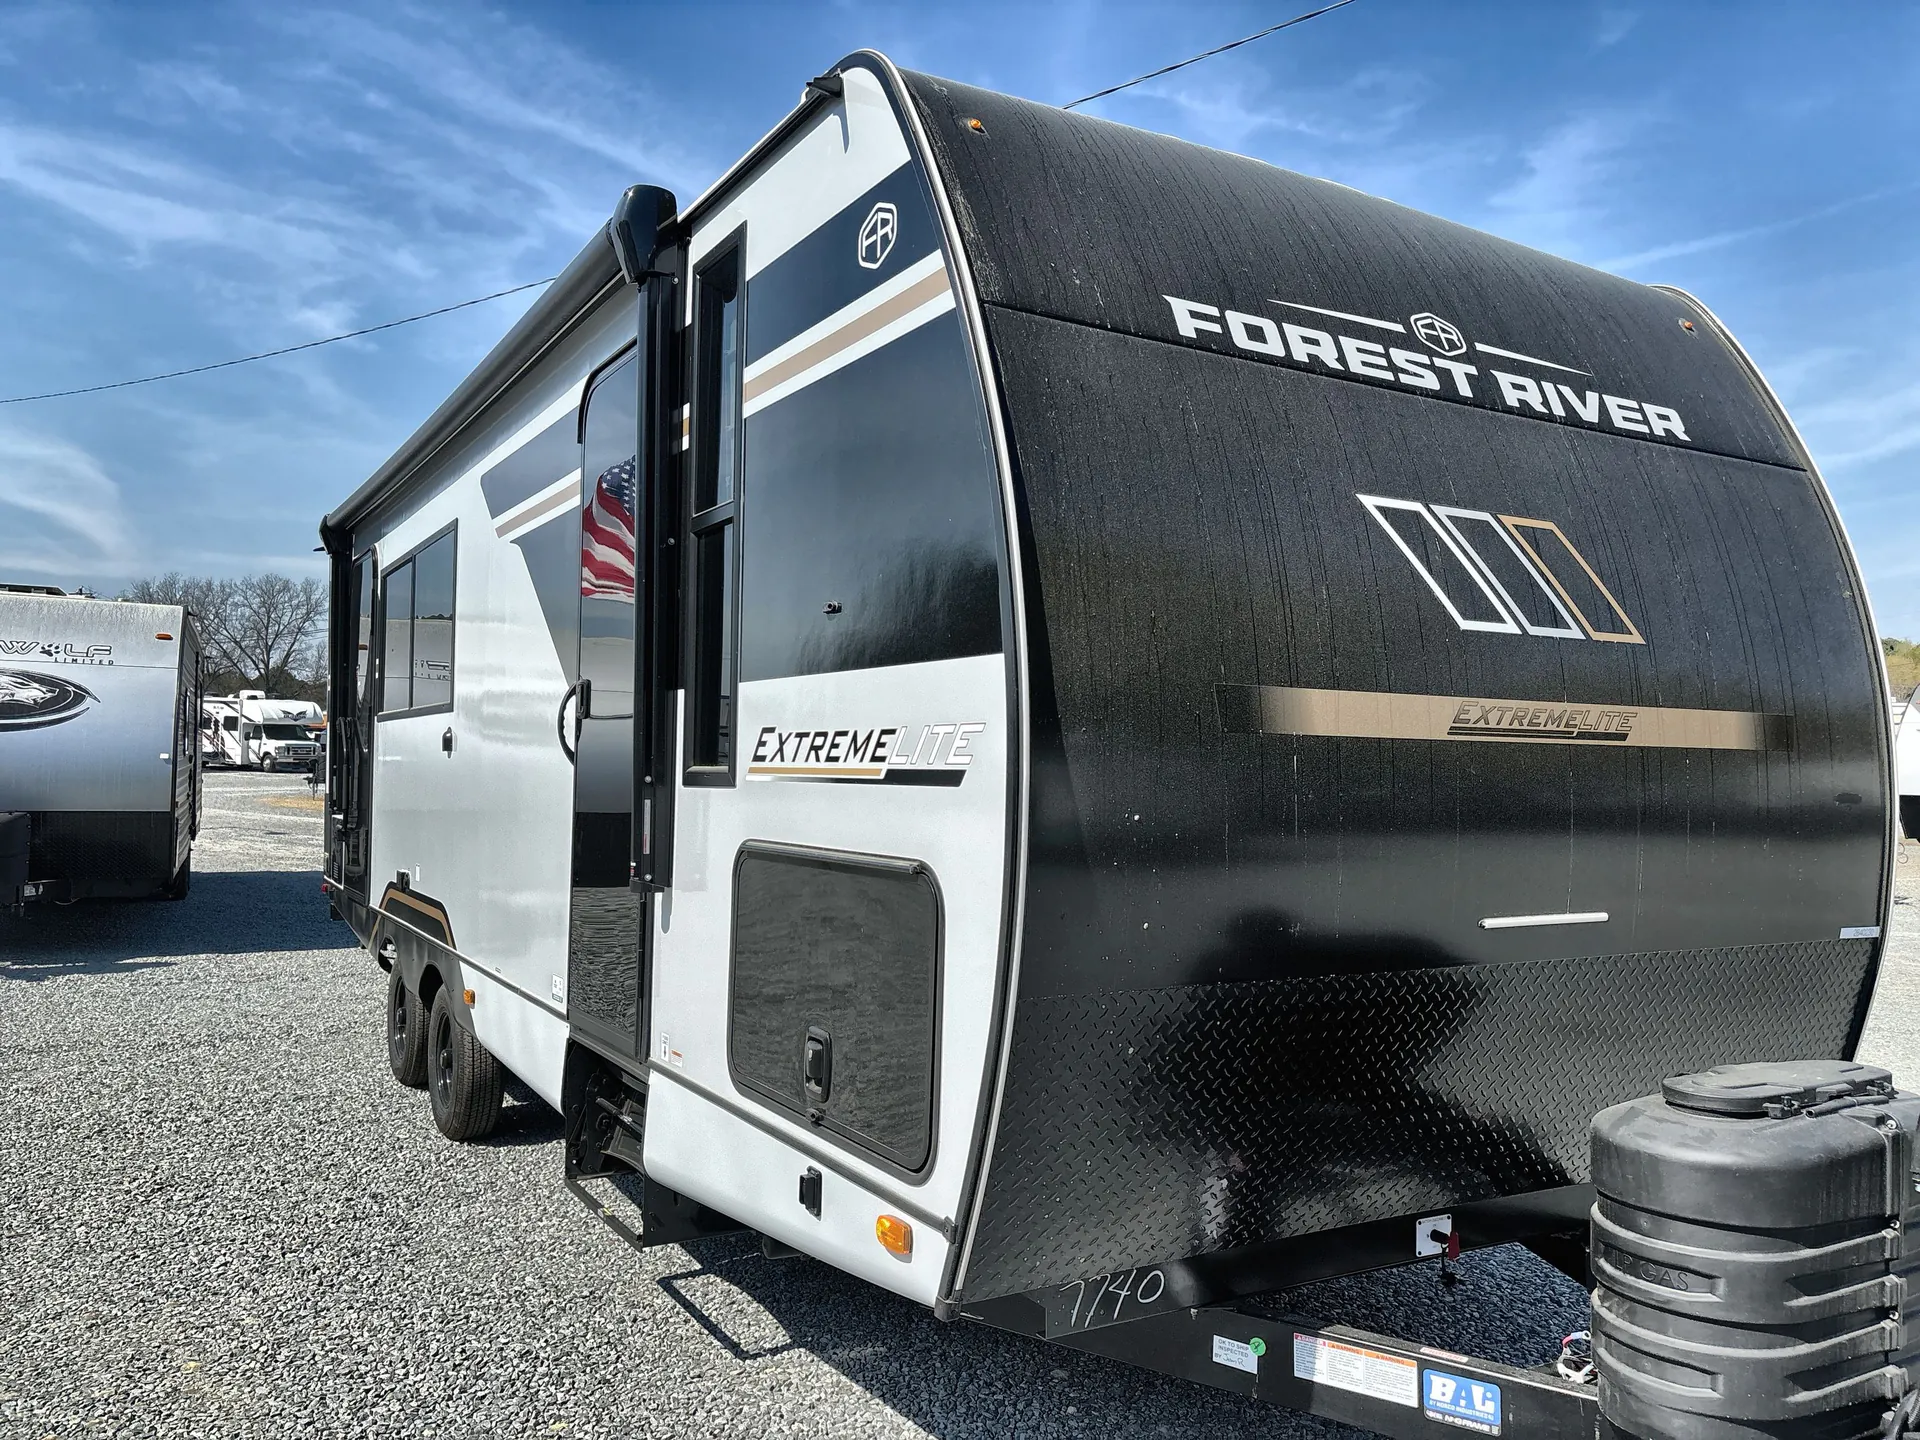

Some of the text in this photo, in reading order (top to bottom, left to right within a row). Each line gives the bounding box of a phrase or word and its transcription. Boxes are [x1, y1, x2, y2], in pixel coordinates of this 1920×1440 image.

[1163, 295, 1692, 442] FOREST RIVER
[54, 657, 114, 666] LIMITED
[1614, 1250, 1689, 1291] LP GAS
[1059, 1269, 1165, 1328] 7740
[1217, 1345, 1249, 1358] INSPECTED
[1236, 1343, 1250, 1352] SHIP
[1379, 1355, 1405, 1365] WARNING
[1430, 1375, 1495, 1414] BAL
